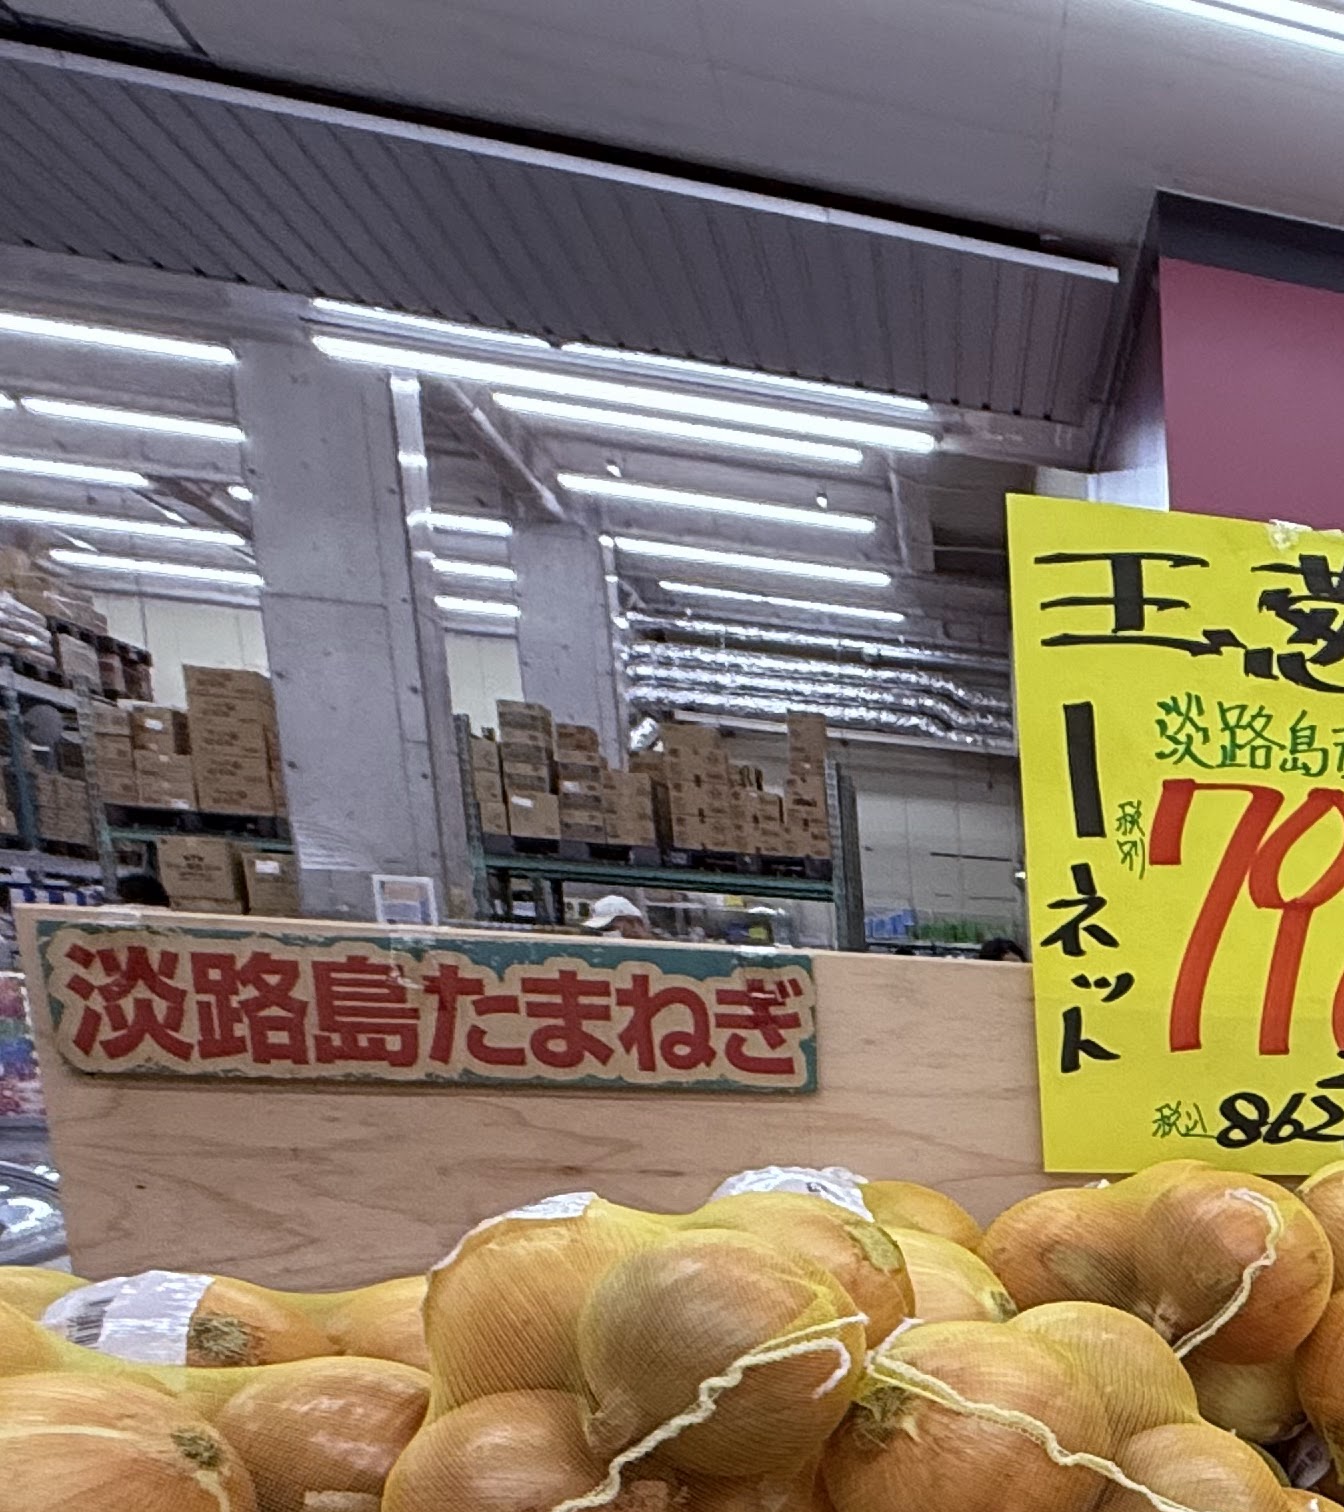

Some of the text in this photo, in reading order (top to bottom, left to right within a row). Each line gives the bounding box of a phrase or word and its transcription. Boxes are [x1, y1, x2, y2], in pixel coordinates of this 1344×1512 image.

[63, 940, 804, 1077] 淡路島たまねぎ
